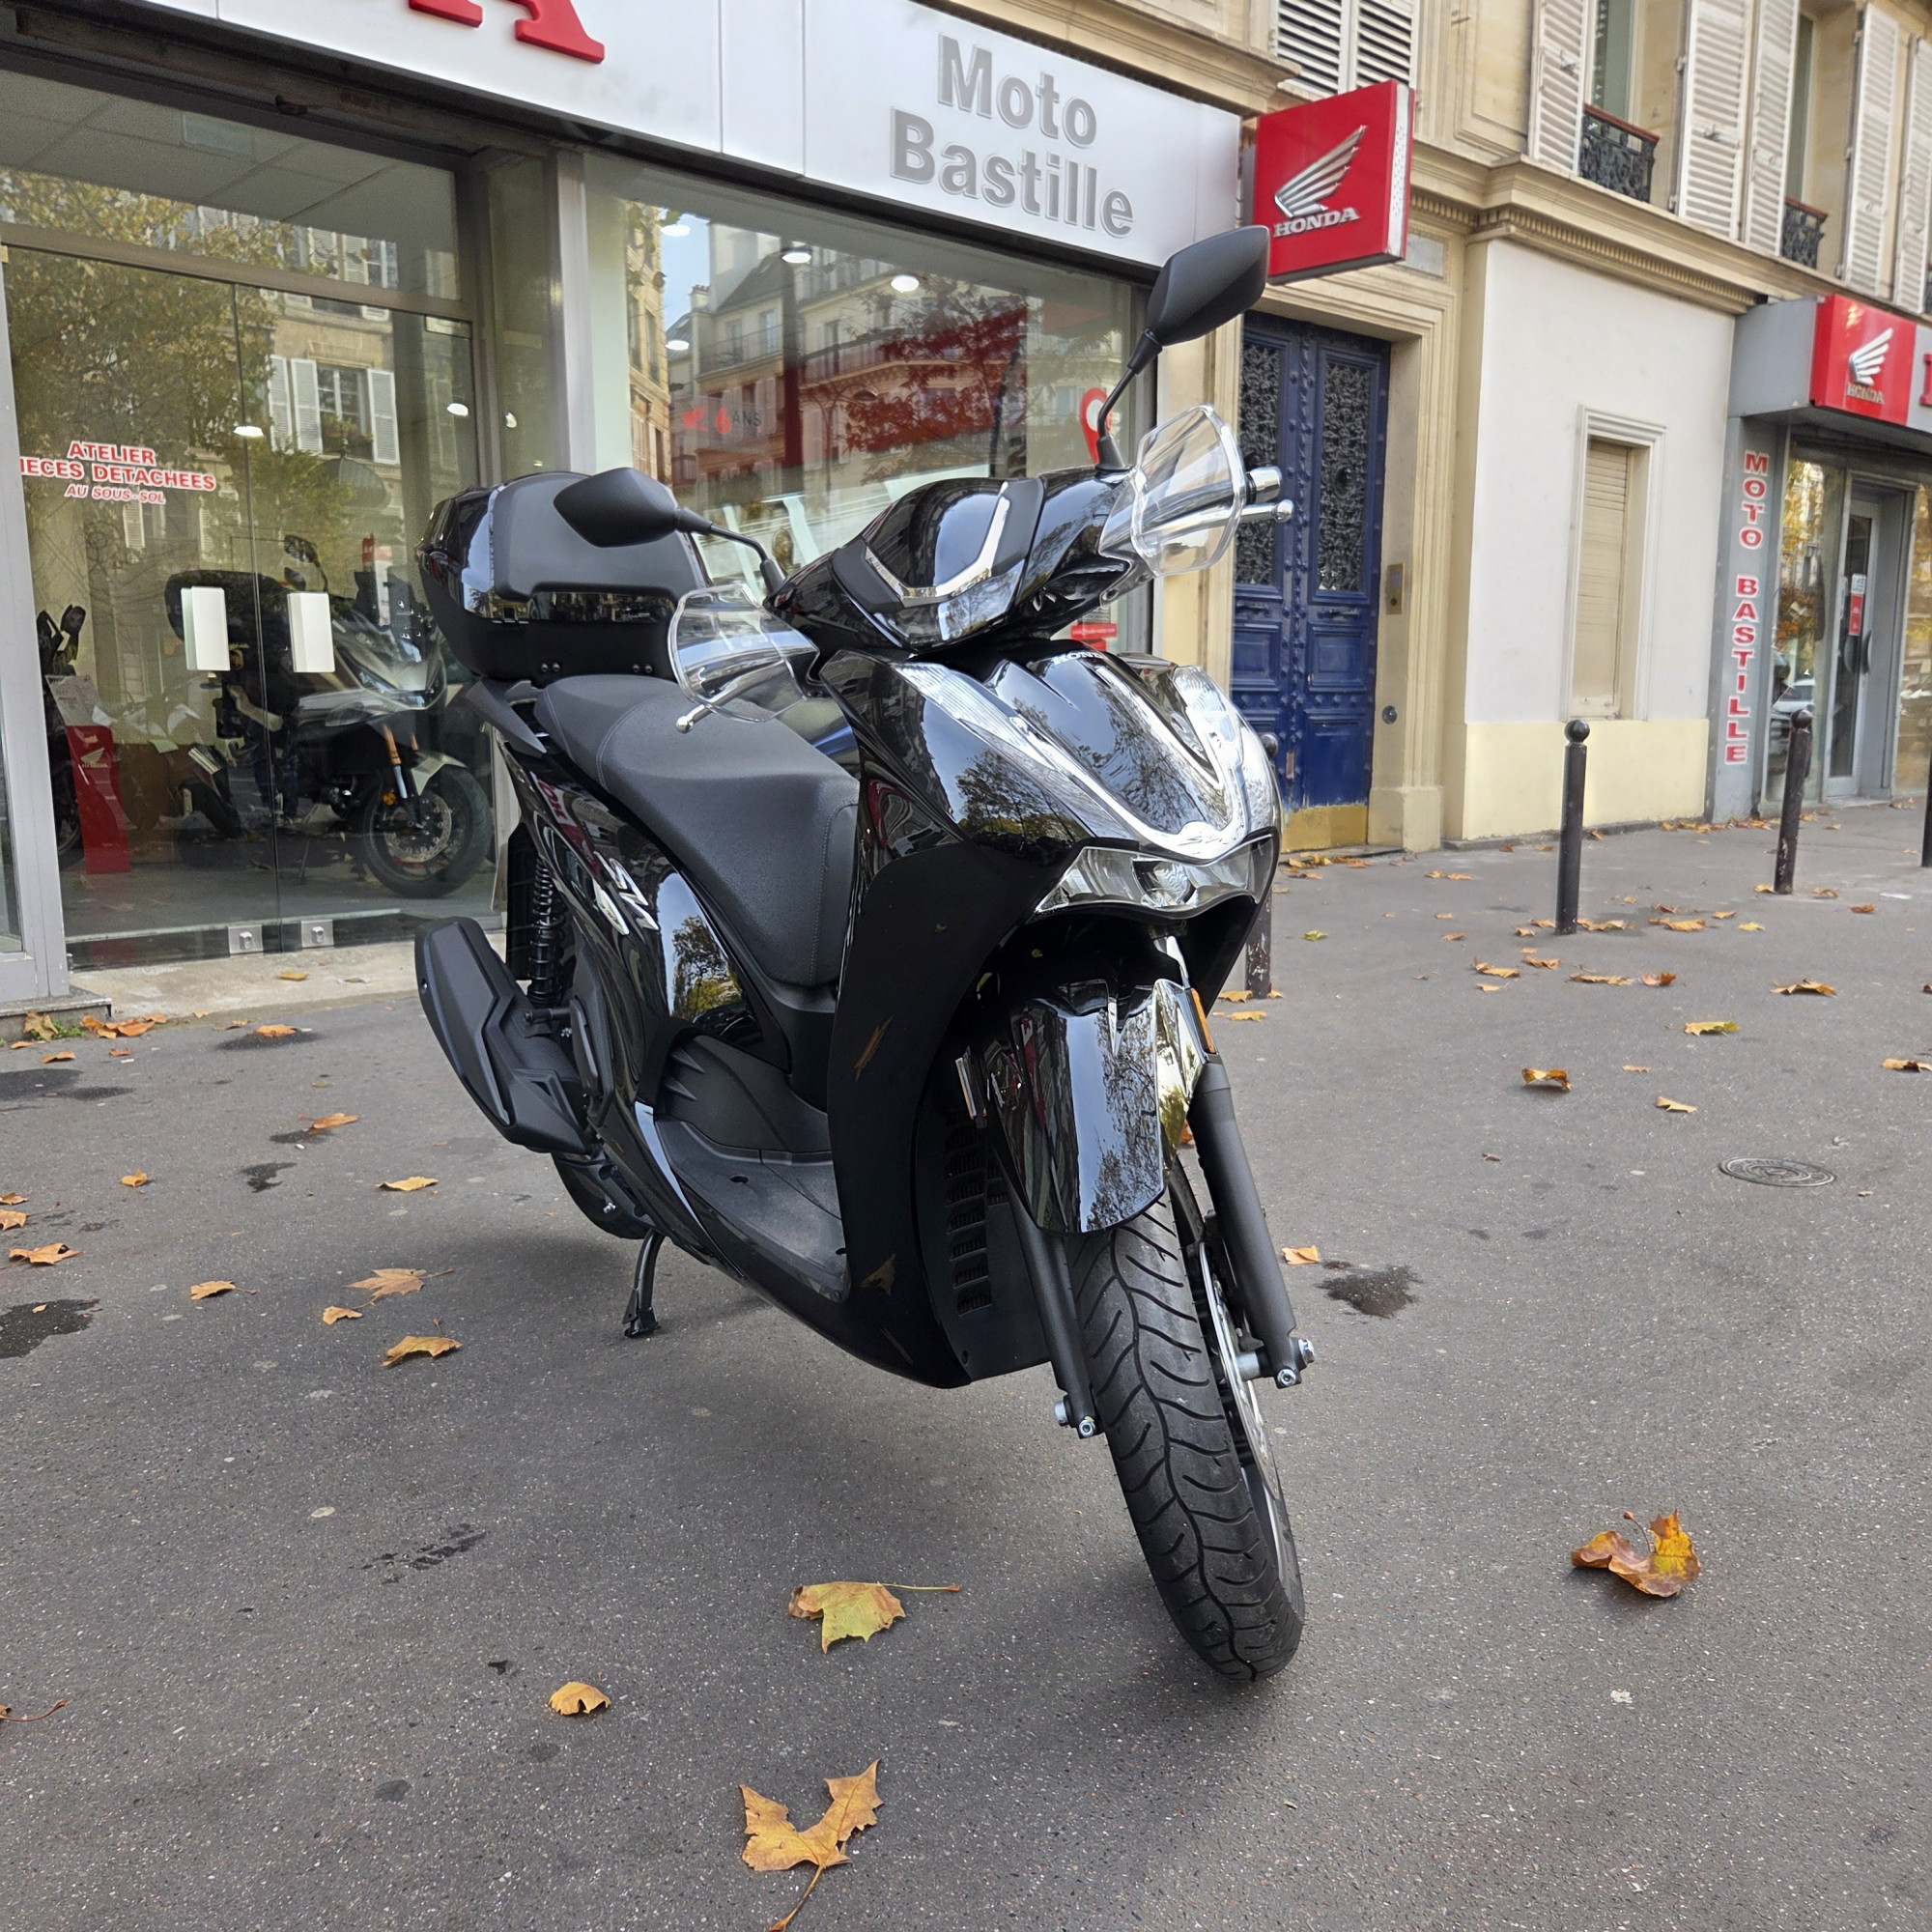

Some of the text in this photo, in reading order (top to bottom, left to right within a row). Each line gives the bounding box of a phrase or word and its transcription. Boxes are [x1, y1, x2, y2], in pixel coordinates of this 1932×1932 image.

[937, 33, 1097, 148] Moto
[890, 106, 1134, 239] Bastille
[1273, 207, 1361, 238] HONDA
[1846, 383, 1885, 406] HONDA
[68, 440, 156, 466] ATELIER
[19, 457, 216, 491] IECES DETACHEES
[65, 484, 89, 497] AU
[1740, 449, 1770, 550] MOTO
[1051, 652, 1104, 666] HOND
[1724, 574, 1761, 765] BASTILLE
